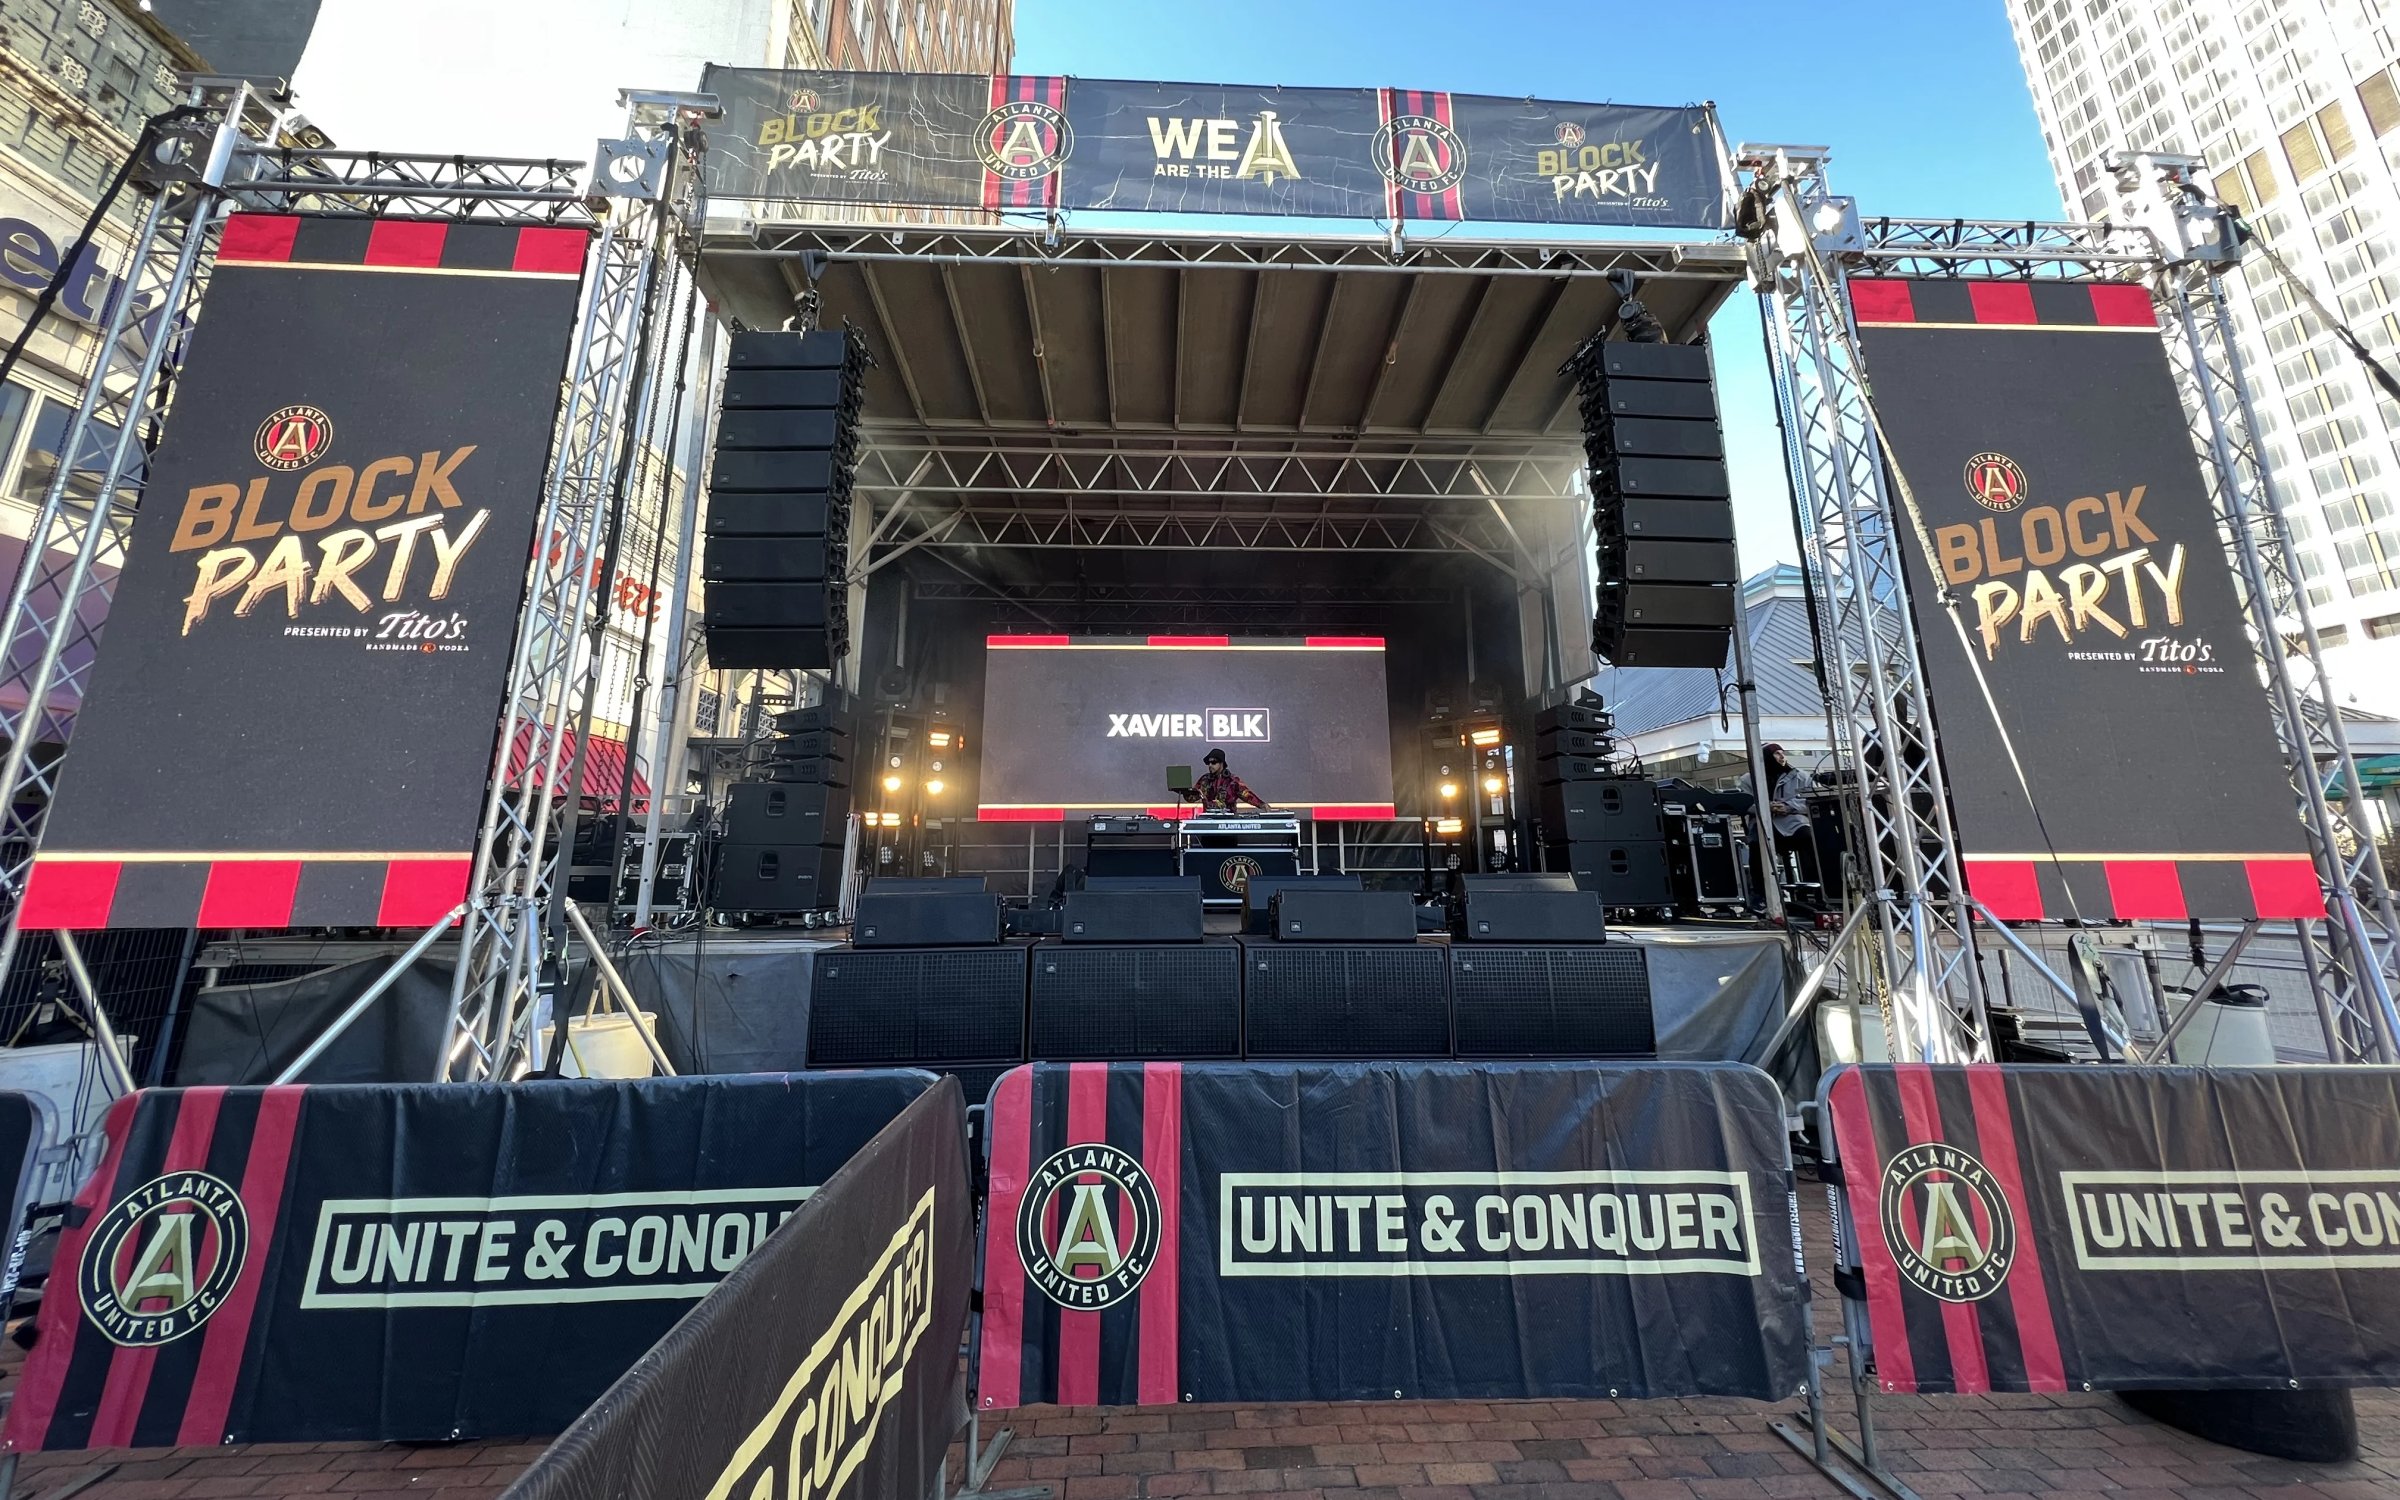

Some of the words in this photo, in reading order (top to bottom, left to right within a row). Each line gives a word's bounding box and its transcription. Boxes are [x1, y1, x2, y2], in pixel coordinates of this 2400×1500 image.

[758, 105, 883, 145] BLOCK
[992, 104, 1060, 124] ATLANTA
[766, 130, 892, 175] PARTY
[1146, 117, 1239, 160] WE
[849, 169, 889, 180] Tito's
[985, 154, 1038, 177] UNITED
[1155, 164, 1191, 177] ARE
[1195, 165, 1232, 179] THE
[1537, 139, 1646, 176] BLOCK
[1385, 169, 1437, 191] UNITED
[1442, 171, 1458, 185] FC
[1552, 161, 1660, 204] PARTY
[1632, 197, 1669, 207] Tito's
[273, 407, 324, 425] ATLANTA
[260, 450, 298, 468] UNITED
[303, 451, 318, 464] FC
[1970, 454, 2013, 468] ATLANTA
[169, 445, 478, 552] BLOCK
[1975, 493, 2011, 510] UNITED
[2012, 493, 2023, 505] FC
[1935, 485, 2159, 585] BLOCK
[181, 508, 492, 638] PARTY
[1971, 542, 2187, 661] PARTY
[283, 627, 351, 637] PRESENTED
[353, 628, 369, 637] BY
[375, 610, 468, 640] Tito's
[438, 644, 470, 652] VODKA
[2068, 652, 2122, 661] PRESENTED
[2124, 652, 2136, 661] BY
[2140, 636, 2212, 662] Tito's
[1106, 713, 1204, 737] XAVIER
[1212, 714, 1264, 737] BLK
[1226, 857, 1255, 867] ATLANTA
[1225, 881, 1244, 892] UNITE
[1042, 1149, 1140, 1189] ATLANTA
[1890, 1149, 1983, 1186] ATLANTA
[126, 1177, 233, 1219] ATLANTA
[1240, 1195, 1408, 1253] UNITE
[1420, 1194, 1466, 1252] &
[1475, 1193, 1742, 1256] CONQUER
[2082, 1192, 2253, 1248] UNITE
[2260, 1192, 2307, 1247] &
[330, 1220, 516, 1284] UNITE
[524, 1219, 577, 1280] &
[1033, 1256, 1109, 1303] UNITED
[1117, 1258, 1143, 1288] FC
[1902, 1252, 1981, 1296] UNITED
[1983, 1252, 2006, 1282] FC
[93, 1293, 174, 1339] UNITED
[187, 1291, 216, 1323] FC
